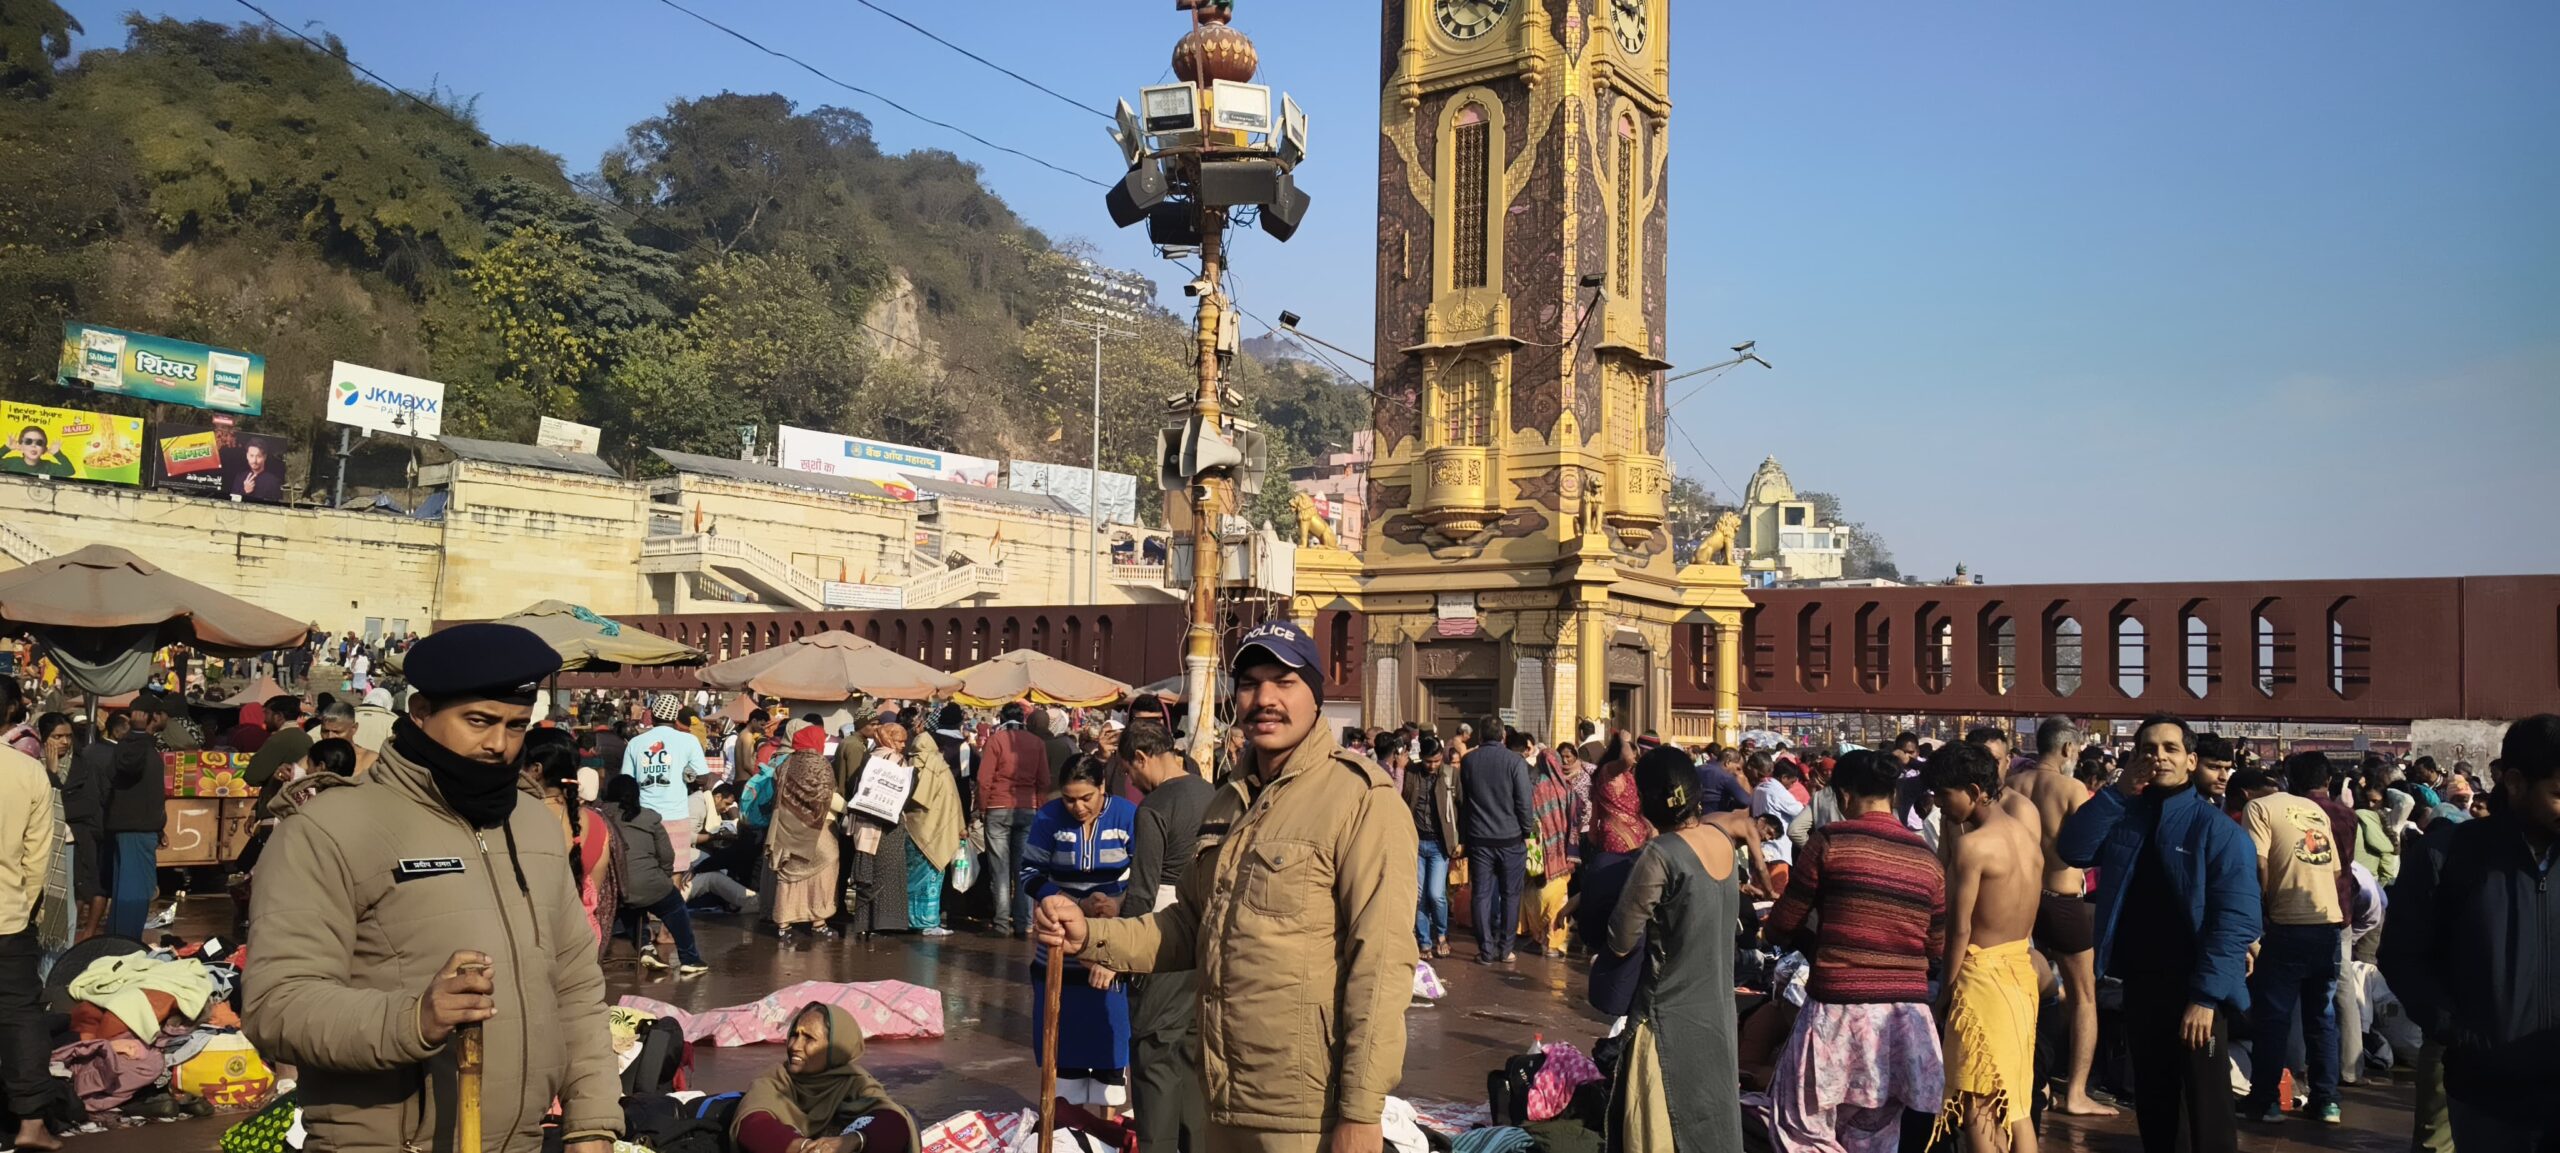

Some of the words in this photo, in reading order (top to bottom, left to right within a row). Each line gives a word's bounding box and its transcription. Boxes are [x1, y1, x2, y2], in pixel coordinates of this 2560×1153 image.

[136, 350, 198, 380] शिखर
[7, 413, 20, 422] my
[13, 407, 37, 416] never
[40, 409, 63, 419] share
[63, 425, 91, 433] MARIO
[1243, 624, 1296, 643] POLICE
[172, 808, 209, 851] 5
